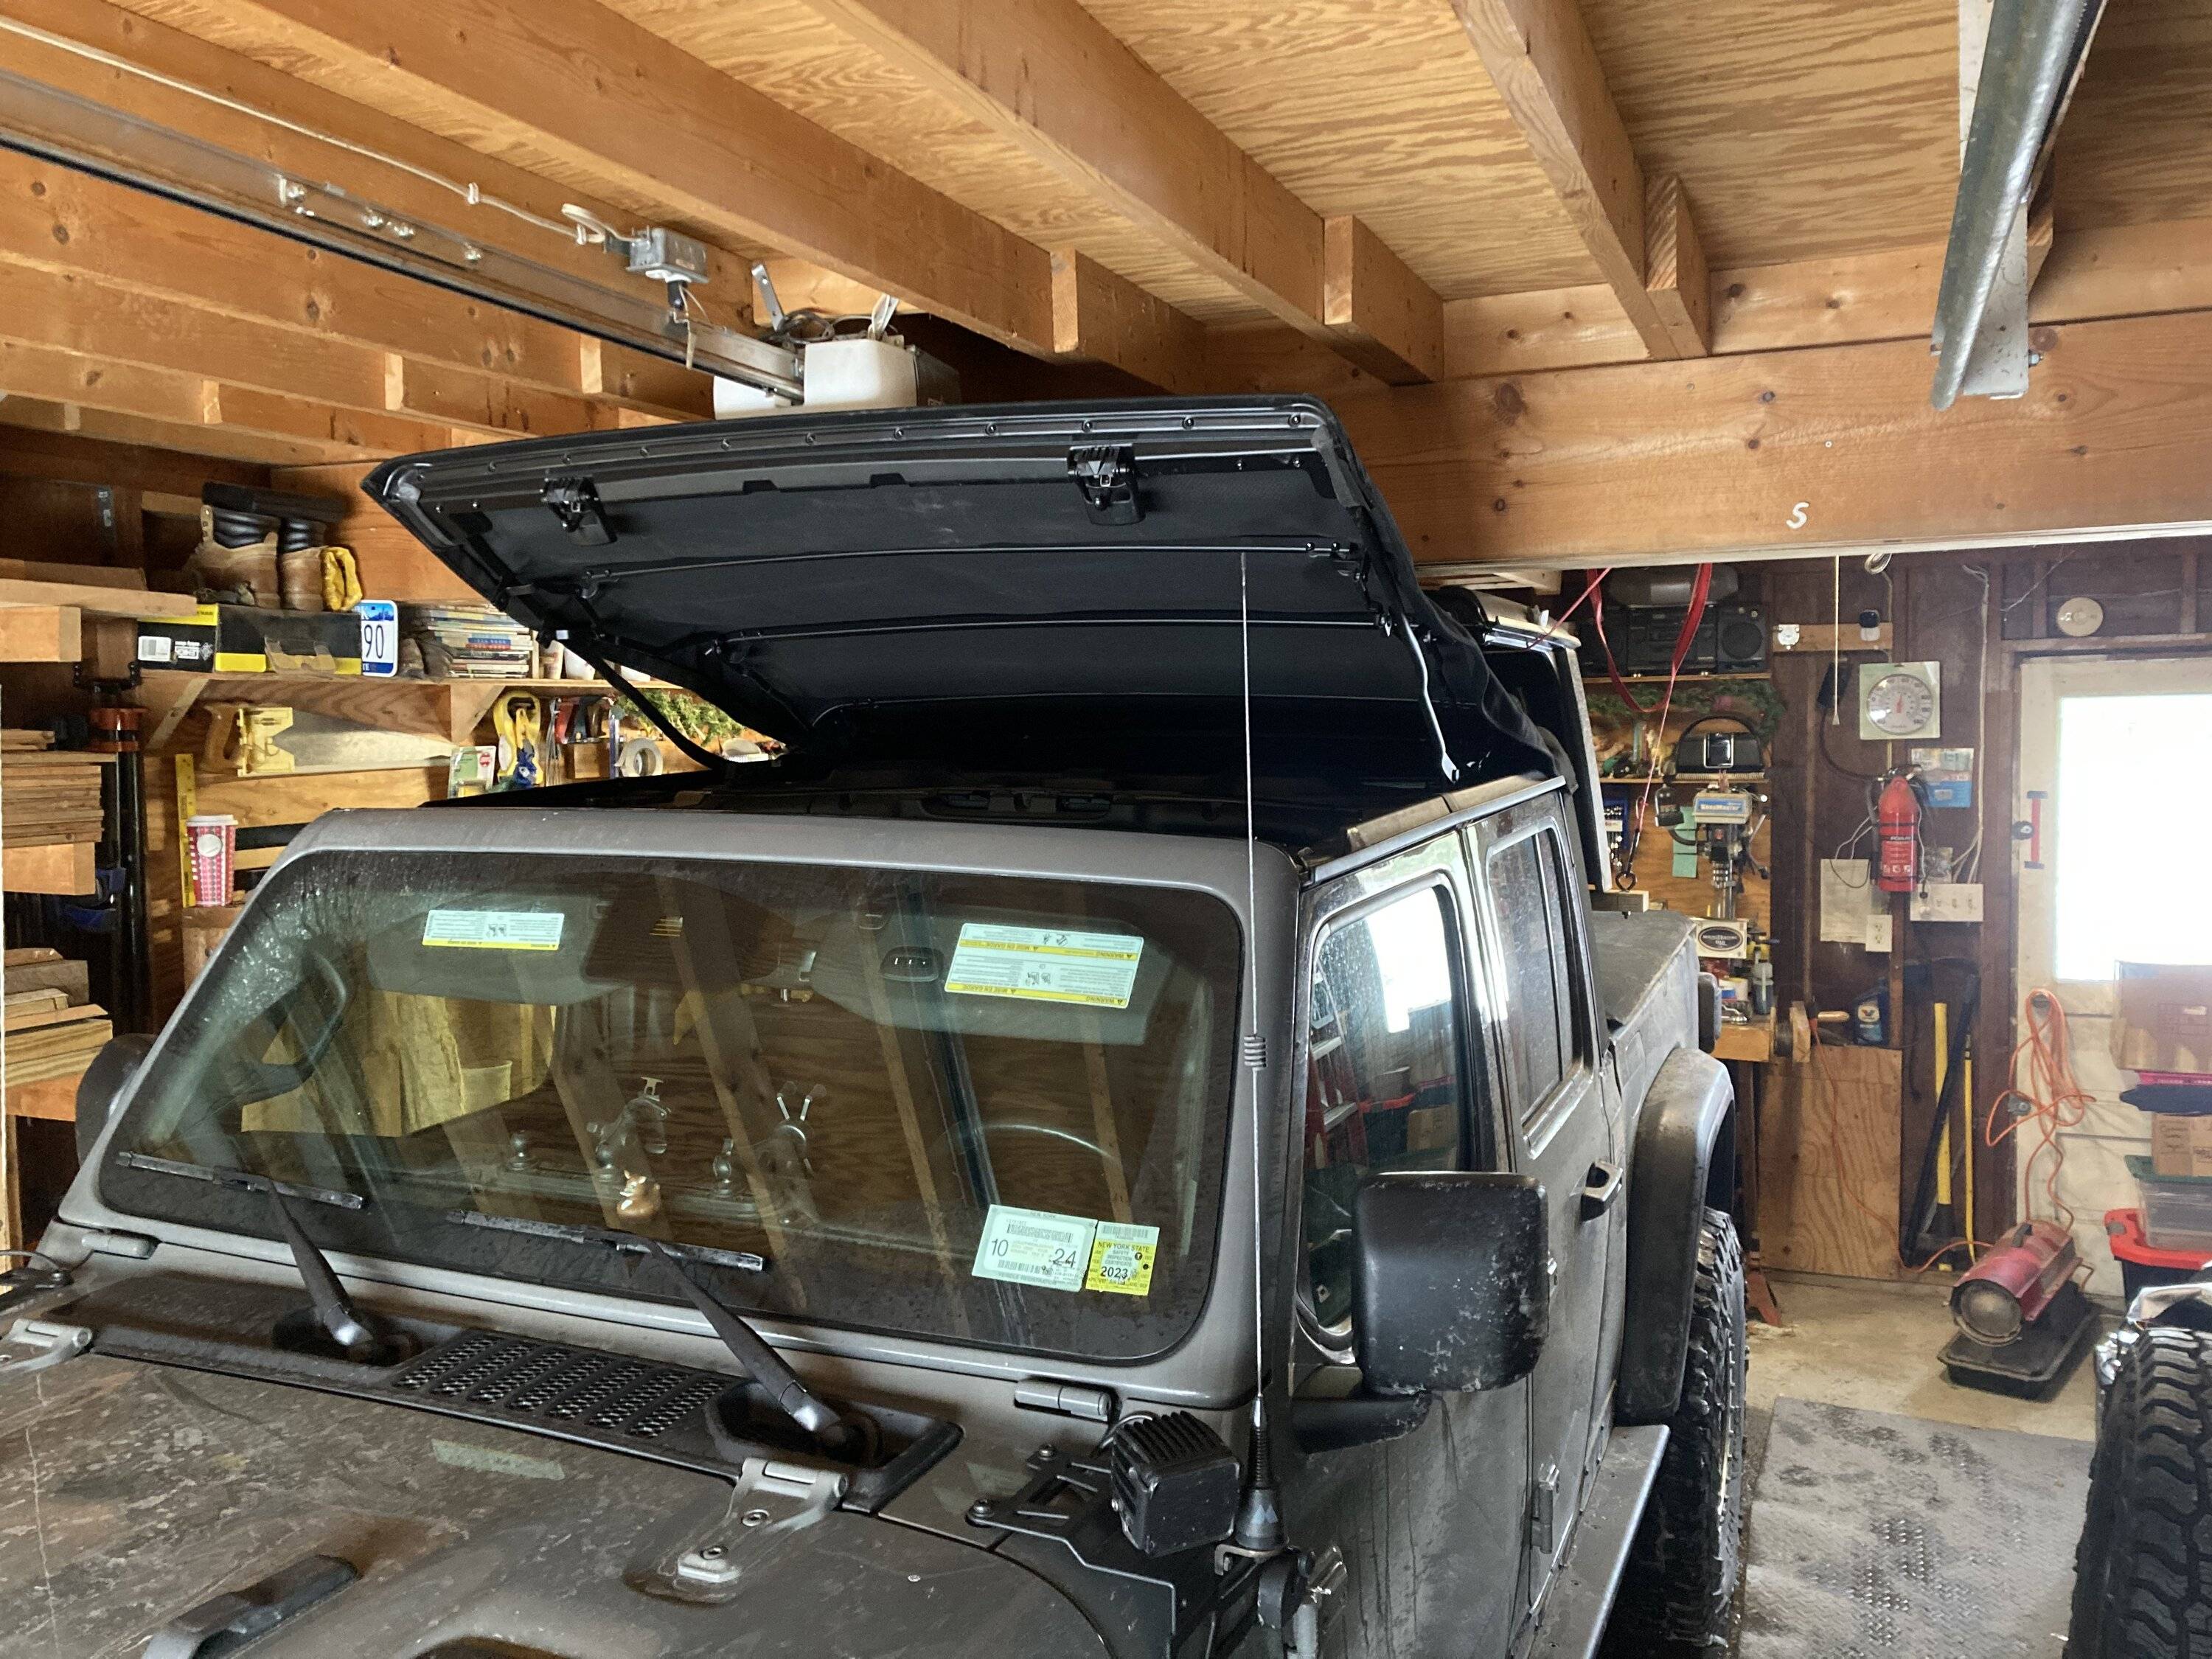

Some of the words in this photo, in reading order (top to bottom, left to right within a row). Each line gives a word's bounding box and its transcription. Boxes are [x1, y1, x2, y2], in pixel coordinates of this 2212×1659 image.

[1786, 501, 1809, 529] S
[364, 624, 384, 659] 90
[991, 1238, 1009, 1257] 10
[1053, 1248, 1077, 1268] 24
[1100, 1266, 1128, 1280] 2023
